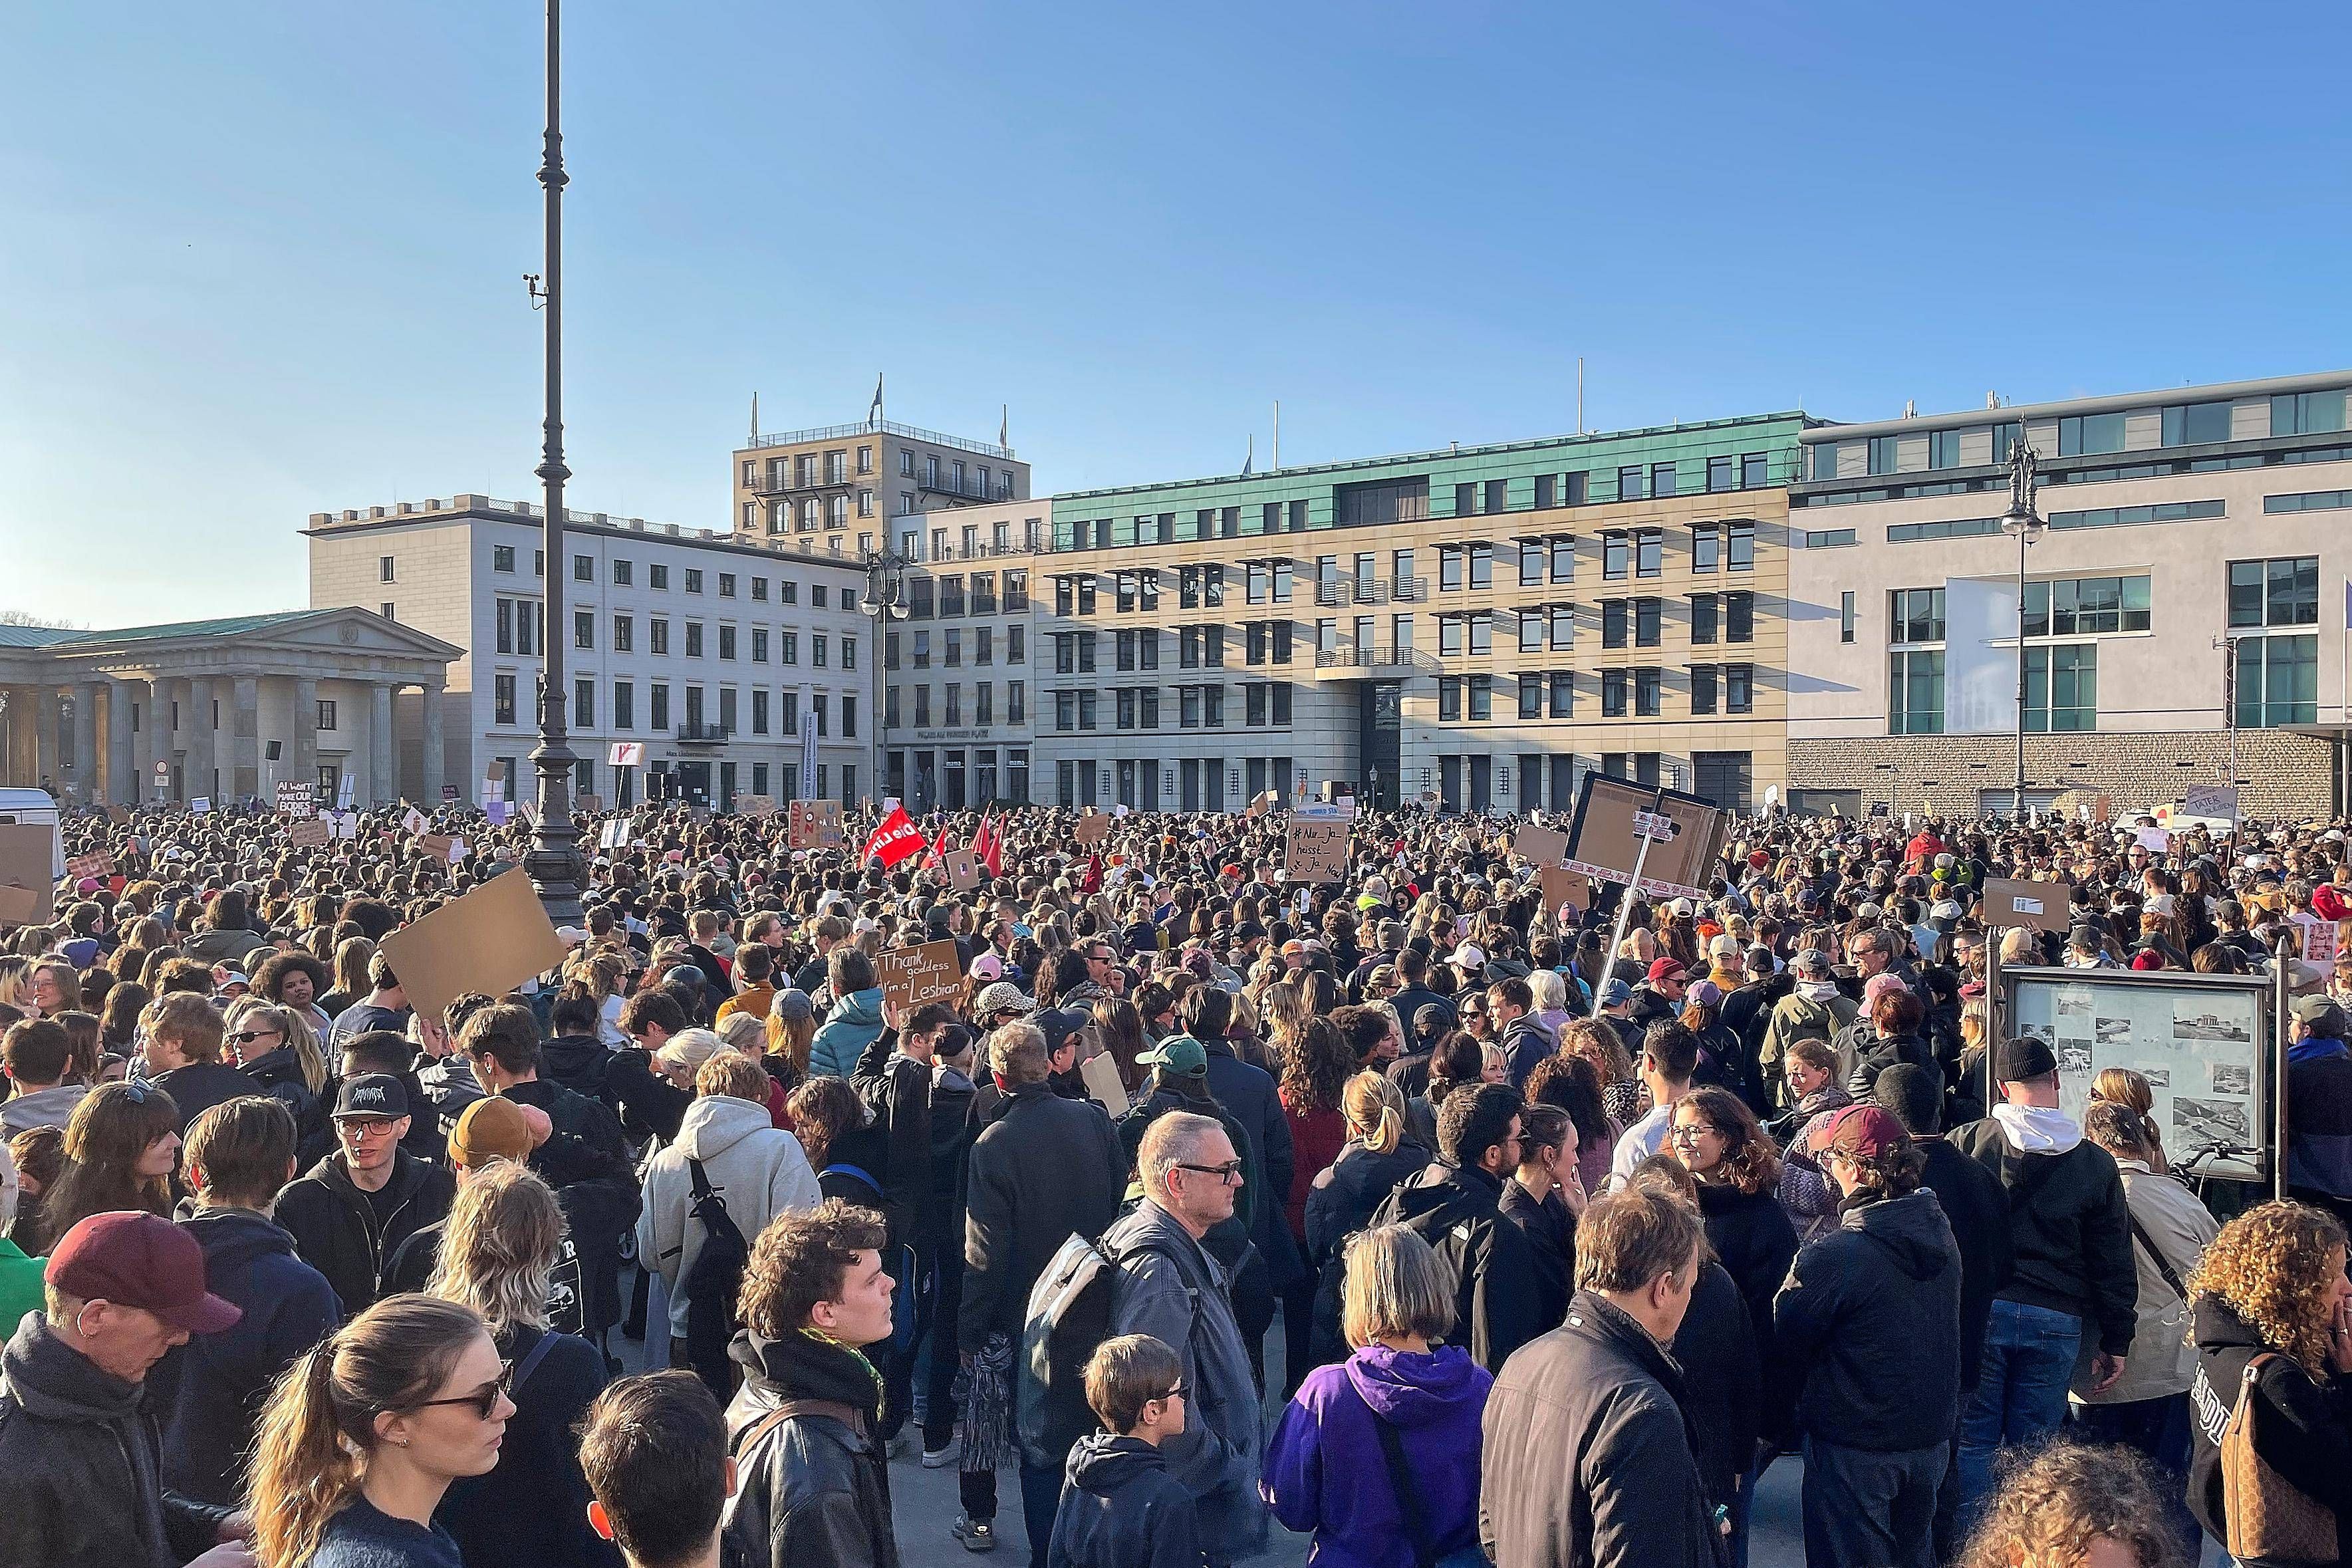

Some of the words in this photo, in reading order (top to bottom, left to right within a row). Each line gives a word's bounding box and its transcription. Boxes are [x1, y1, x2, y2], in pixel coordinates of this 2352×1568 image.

[296, 791, 311, 801] OUR
[279, 801, 311, 811] BODIES
[1305, 856, 1321, 872] Ja
[878, 947, 924, 972] Thank
[907, 959, 950, 979] goddess
[884, 980, 898, 993] I'm
[909, 972, 960, 1003] Lesbian
